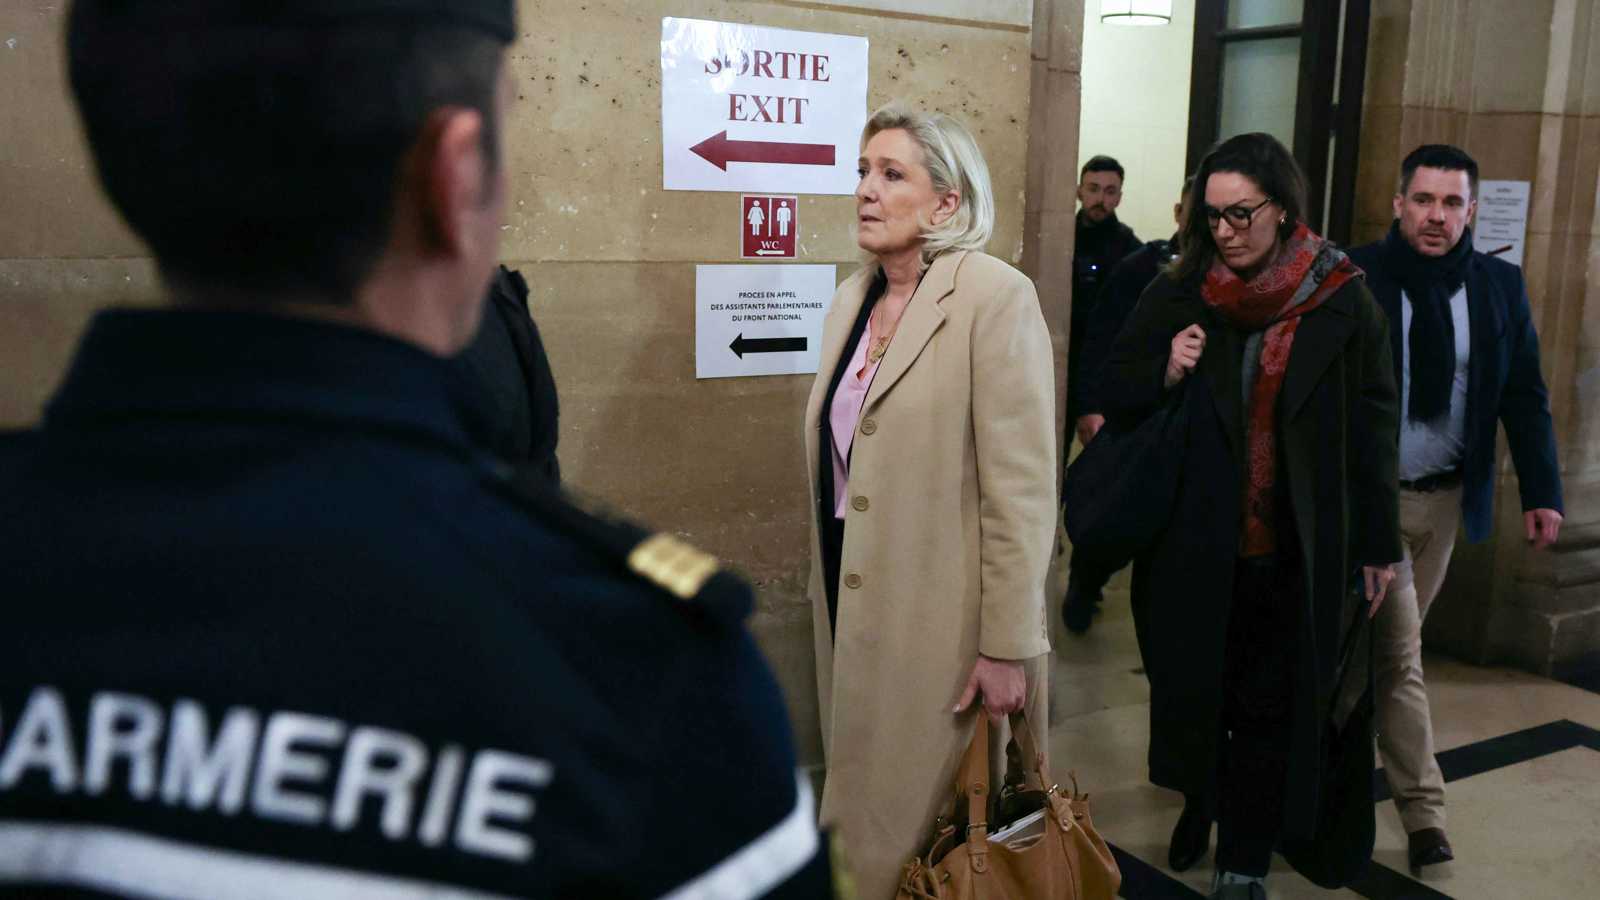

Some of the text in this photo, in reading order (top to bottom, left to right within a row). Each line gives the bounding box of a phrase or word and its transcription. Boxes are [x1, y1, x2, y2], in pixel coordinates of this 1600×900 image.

[728, 93, 809, 124] EXIT
[760, 240, 780, 249] WC
[0, 685, 554, 863] ARMERIE
